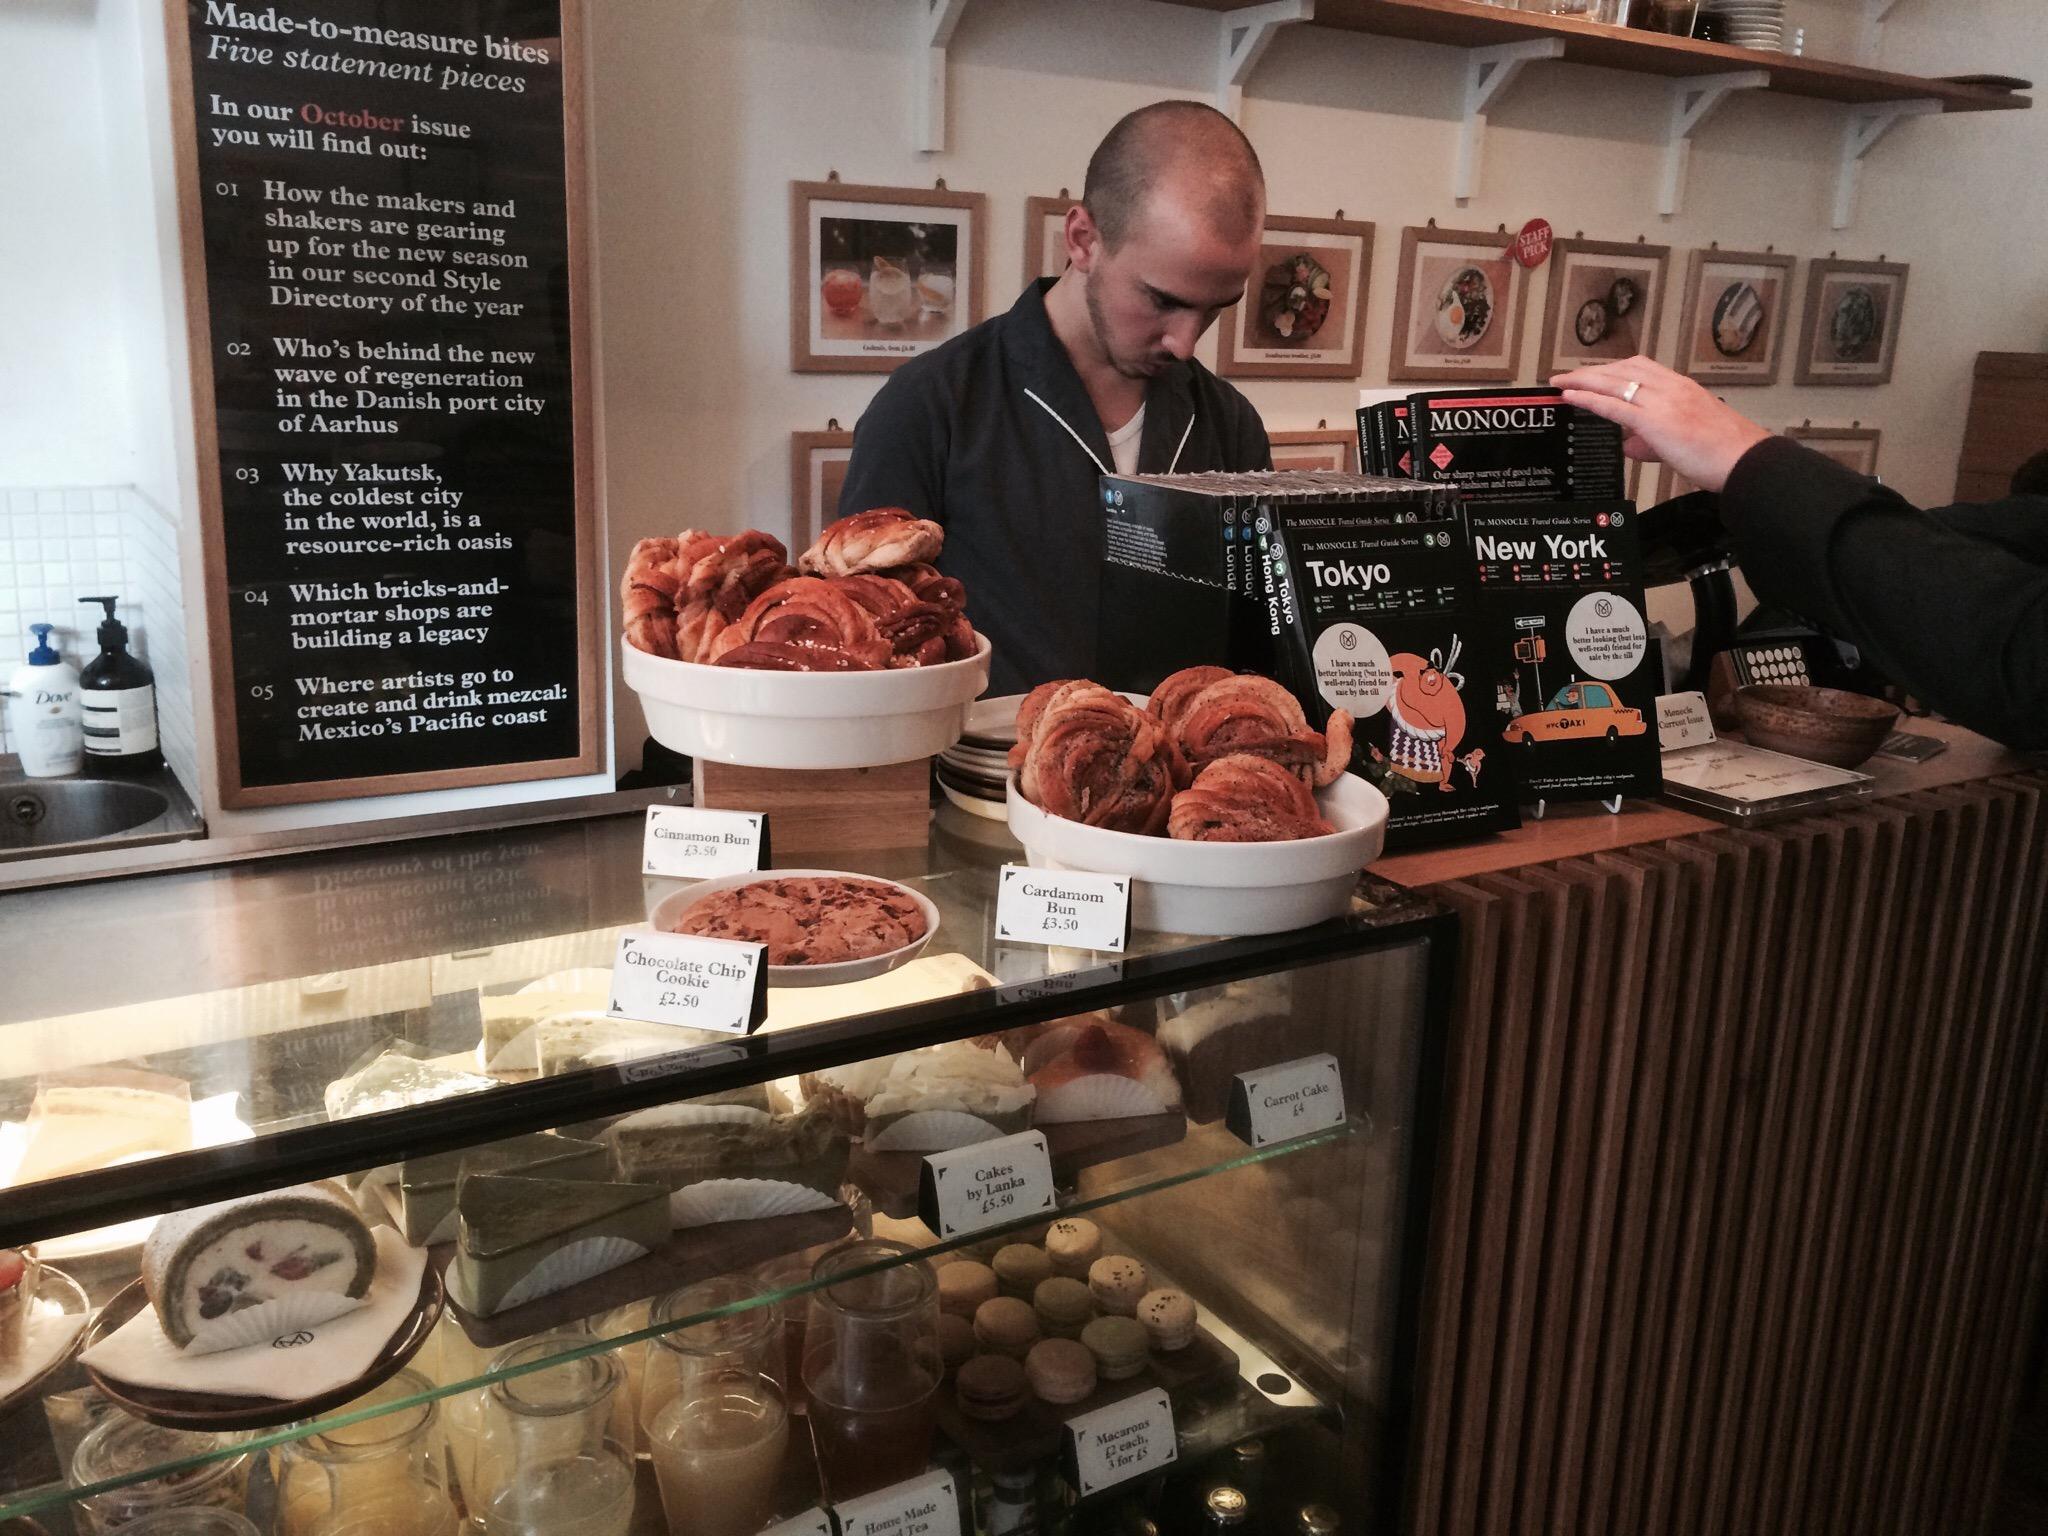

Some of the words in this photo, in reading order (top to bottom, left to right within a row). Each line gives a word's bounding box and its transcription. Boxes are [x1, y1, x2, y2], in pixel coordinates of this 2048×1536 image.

[206, 1, 477, 56] Made-to-measure
[485, 34, 550, 64] bites
[208, 34, 273, 64] Five
[283, 48, 433, 82] statement
[441, 64, 525, 93] pieces
[210, 94, 239, 116] In
[248, 103, 293, 121] our
[301, 103, 404, 133] October
[412, 114, 471, 138] issue
[212, 128, 259, 147] you
[267, 129, 314, 150] will
[323, 133, 372, 155] find
[379, 143, 427, 160] out:
[215, 183, 238, 198] 01
[264, 180, 322, 202] How
[330, 186, 369, 207] the
[377, 191, 465, 214] makers
[473, 199, 515, 218] and
[265, 208, 361, 232] shakers
[370, 218, 409, 235] are
[417, 220, 505, 245] gearing
[1520, 227, 1549, 246] STAFF
[267, 238, 299, 258] up
[308, 236, 344, 257] for
[352, 240, 390, 259] the
[398, 246, 445, 263] new
[452, 251, 528, 267] season
[1523, 242, 1548, 259] PICK
[269, 261, 294, 279] in
[302, 266, 345, 282] our
[353, 269, 436, 287] second
[443, 270, 501, 293] Style
[270, 285, 393, 313] Directory
[401, 292, 428, 312] of
[431, 294, 467, 313] the
[474, 301, 524, 318] year
[227, 342, 251, 356] 02
[358, 341, 441, 362] behind
[447, 343, 484, 363] the
[491, 349, 535, 364] new
[274, 367, 337, 383] wave
[345, 366, 371, 384] of
[376, 367, 524, 389] regeneration
[277, 389, 301, 407] in
[310, 389, 348, 407] the
[356, 390, 441, 409] Danish
[449, 394, 498, 415] port
[505, 394, 545, 414] city
[278, 415, 303, 432] of
[310, 416, 398, 433] Aarhus
[1430, 408, 1556, 431] MONOCLE
[1360, 416, 1368, 455] MONOCLE
[236, 467, 260, 483] 03
[282, 463, 338, 484] Why
[342, 463, 442, 484] Yakutsk,
[283, 489, 322, 506] the
[330, 489, 414, 506] coldest
[420, 488, 463, 508] city
[285, 513, 310, 530] in
[316, 512, 355, 530] the
[362, 511, 437, 531] world,
[442, 512, 461, 528] is
[468, 513, 481, 527] a
[286, 535, 451, 555] resource-rich
[458, 533, 512, 550] oasis
[1302, 543, 1314, 551] The
[1316, 541, 1358, 550] MONOCLE
[1380, 539, 1399, 547] Guide
[1401, 538, 1419, 546] Series
[1475, 535, 1536, 560] New
[1543, 534, 1607, 559] York
[1262, 555, 1275, 594] Hong
[1306, 560, 1391, 591] Tokyo
[244, 589, 269, 606] 04
[289, 583, 369, 602] Which
[376, 578, 509, 598] bricks-and-
[1278, 579, 1293, 625] Tokyo
[291, 607, 378, 626] mortar
[386, 604, 449, 623] shops
[457, 604, 492, 618] are
[1268, 597, 1280, 636] Kong
[293, 630, 392, 649] building
[399, 629, 412, 643] a
[419, 625, 489, 644] legacy
[1578, 644, 1610, 652] well-read)
[1593, 635, 1616, 643] looking
[1618, 634, 1631, 642] (but
[251, 684, 274, 699] 05
[295, 677, 374, 695] Where
[381, 670, 454, 690] artists
[461, 671, 487, 689] go
[493, 667, 514, 683] to
[36, 690, 72, 704] Dove
[297, 700, 368, 718] create
[375, 695, 416, 713] and
[423, 691, 482, 710] drink
[488, 685, 568, 704] mezcal:
[410, 712, 485, 732] Pacific
[492, 708, 547, 726] coast
[1659, 720, 1686, 729] Current
[1687, 716, 1704, 724] Issue
[1664, 707, 1693, 717] Monocle
[654, 827, 720, 843] Cinnamon
[724, 833, 750, 845] Bun
[684, 845, 717, 857] £3.50
[1022, 884, 1104, 903] Cardamom
[1047, 902, 1076, 915] Bun
[1042, 917, 1078, 931] £3.50
[625, 951, 703, 973] Chocolate
[709, 962, 746, 979] Chip
[656, 970, 710, 988] Cookie
[659, 992, 699, 1008] £2.50
[1264, 1092, 1300, 1108] Carrot
[1302, 1084, 1328, 1097] Cake
[1294, 1102, 1304, 1117] £4
[975, 1165, 1013, 1182] Cakes
[967, 1189, 982, 1200] by
[985, 1178, 1025, 1196] Lanka
[982, 1194, 1014, 1214] £5.50
[1097, 1420, 1150, 1446] Macarons
[1105, 1445, 1116, 1459] £2
[1117, 1454, 1134, 1467] for
[1137, 1447, 1148, 1460] £5
[865, 1517, 901, 1536] Home
[904, 1503, 937, 1522] Made
[908, 1523, 928, 1536] Tea
